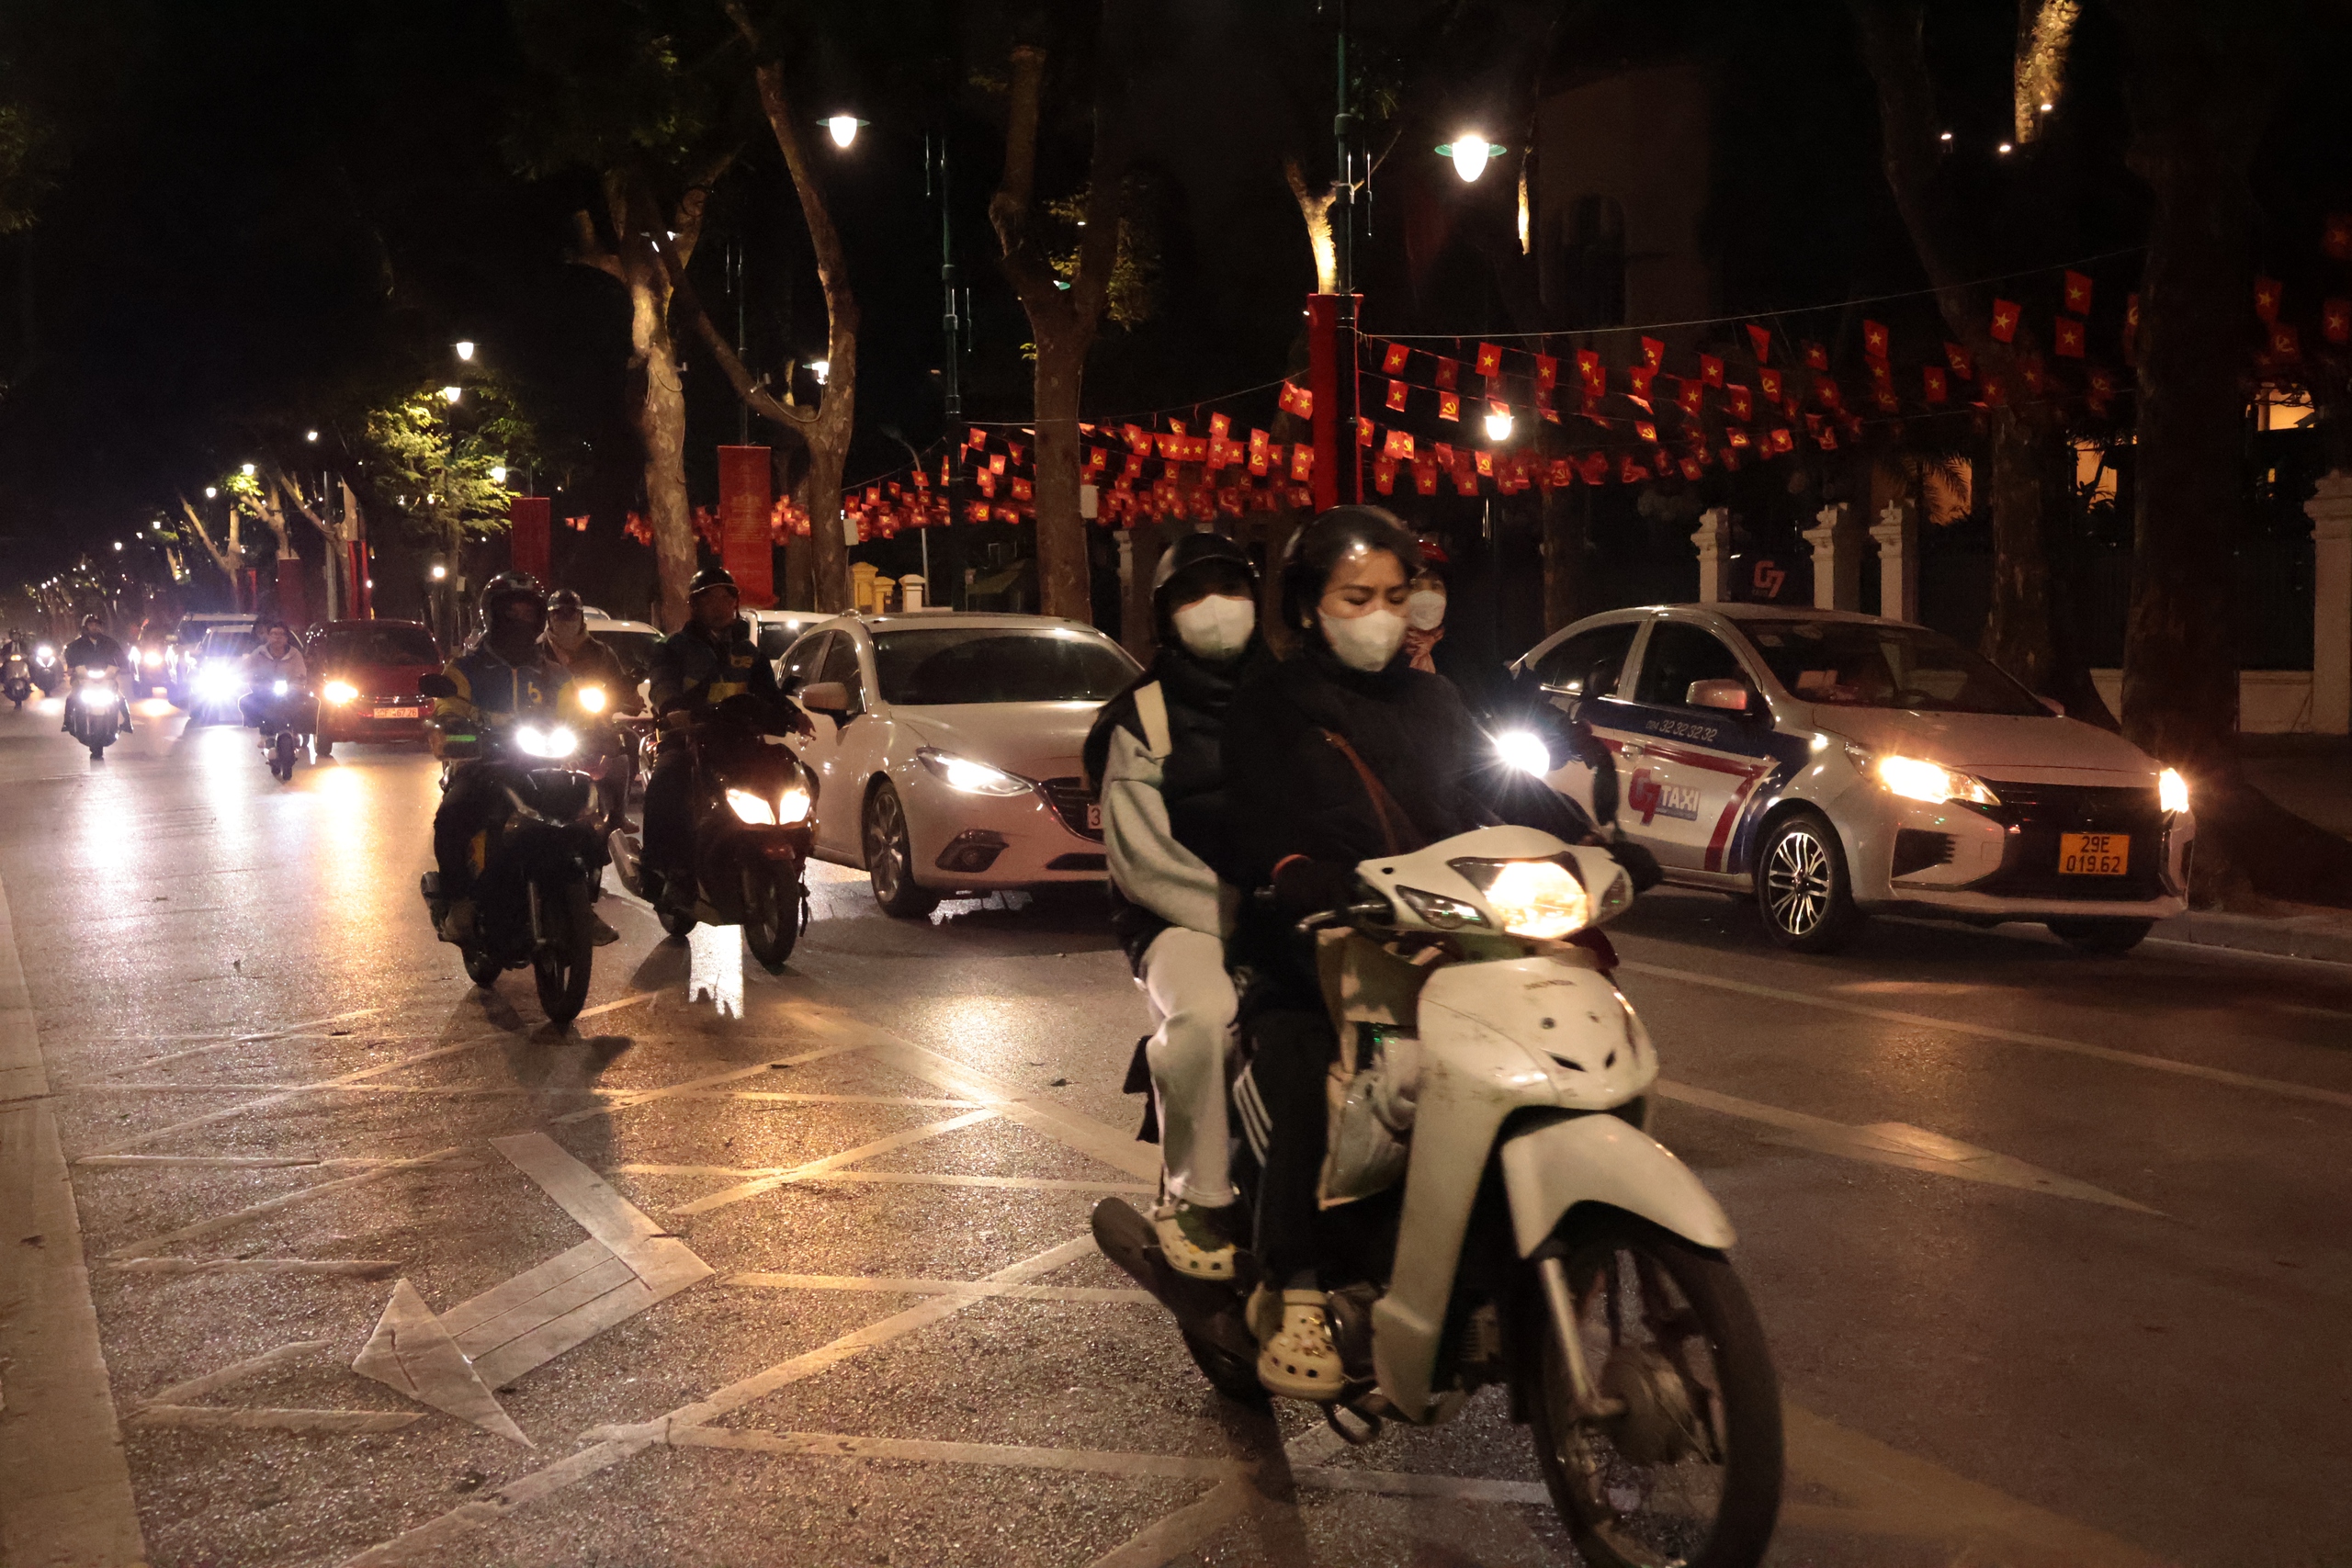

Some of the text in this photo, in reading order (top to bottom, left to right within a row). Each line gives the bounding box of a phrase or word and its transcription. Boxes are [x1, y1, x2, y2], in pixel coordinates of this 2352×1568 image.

[1661, 785, 1699, 812] TAXI
[2080, 836, 2110, 853] 29E
[2066, 855, 2120, 873] 019.62
